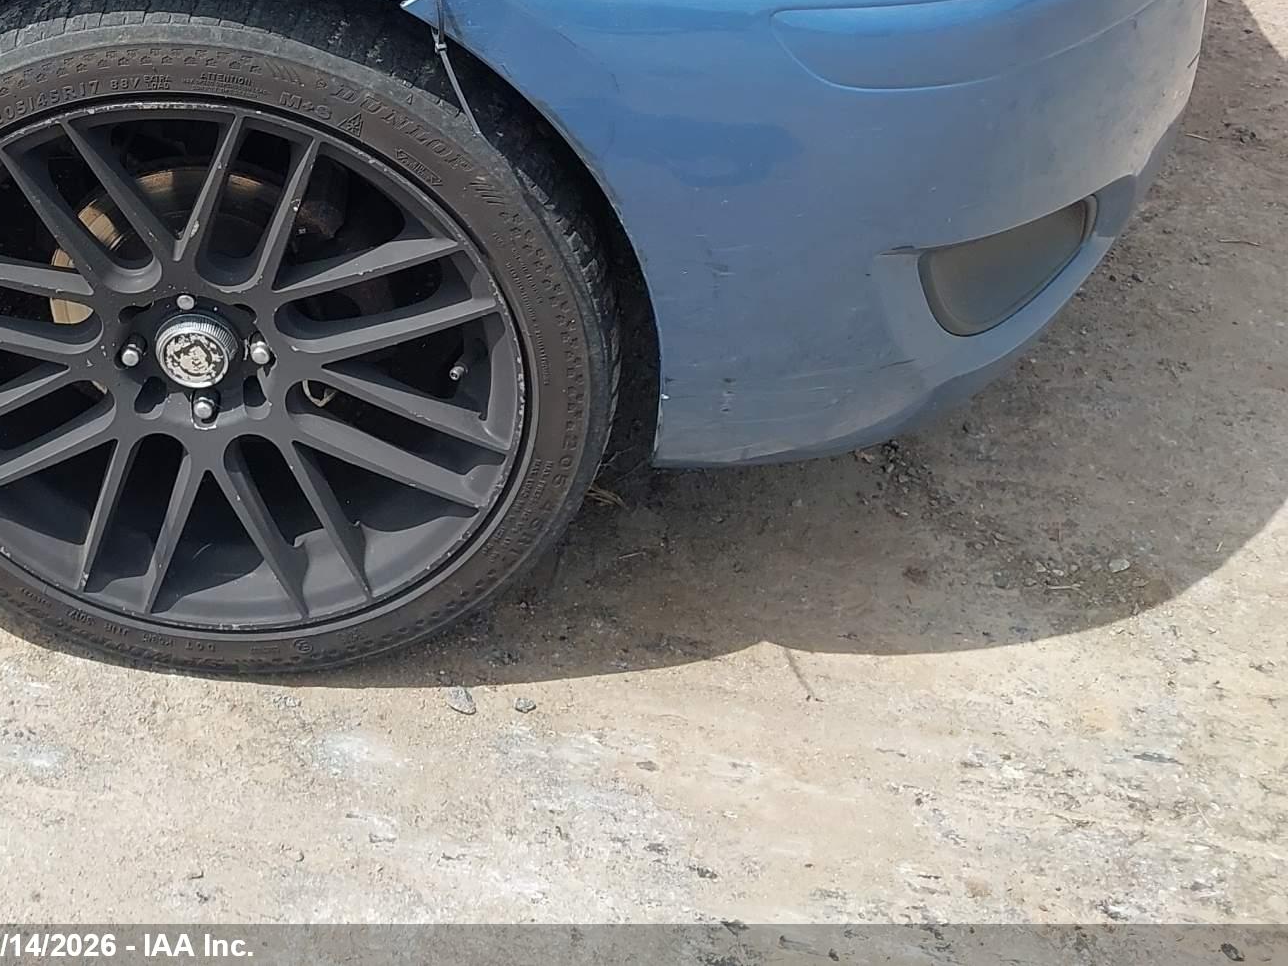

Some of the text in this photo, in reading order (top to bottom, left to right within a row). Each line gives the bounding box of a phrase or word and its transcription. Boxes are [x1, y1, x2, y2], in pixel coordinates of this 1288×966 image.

[110, 77, 140, 91] 88V
[278, 91, 333, 121] M+S
[329, 84, 474, 173] DUNLOP
